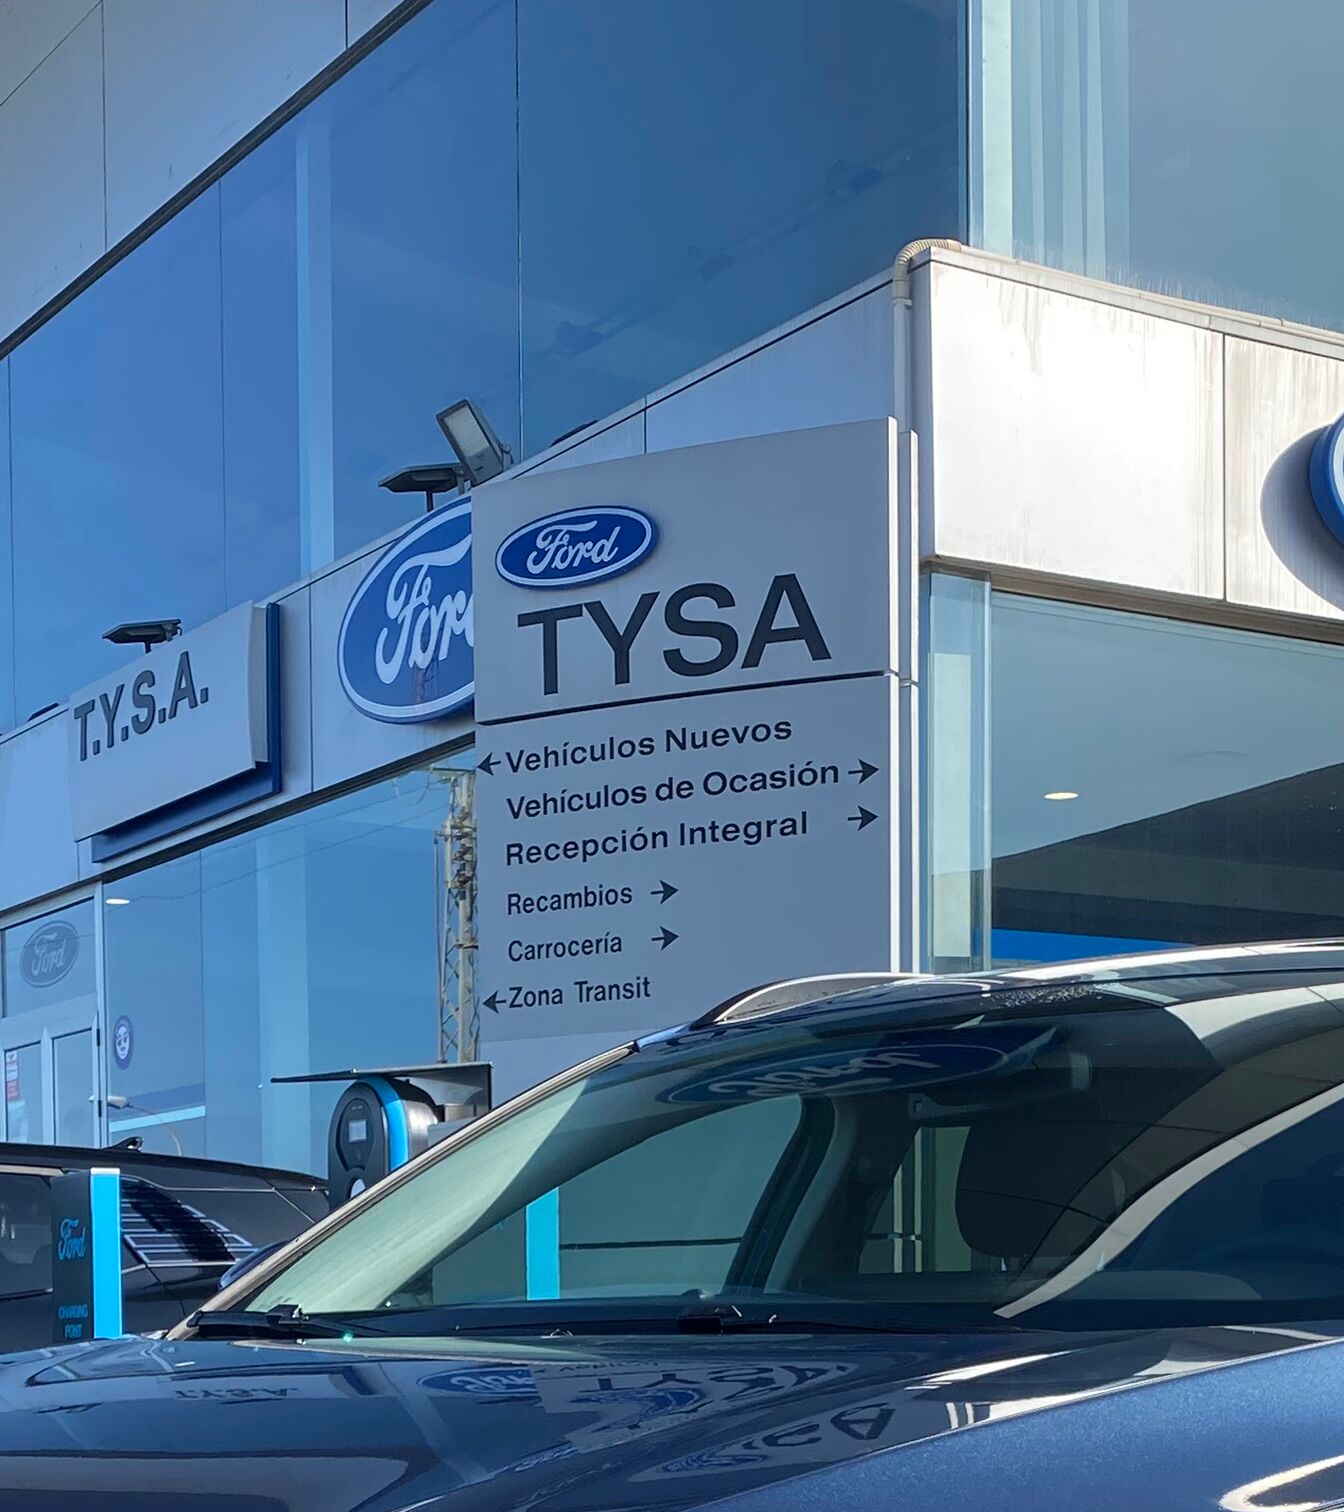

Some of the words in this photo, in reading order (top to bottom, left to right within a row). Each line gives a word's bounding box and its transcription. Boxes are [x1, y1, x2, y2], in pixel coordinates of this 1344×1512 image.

[527, 520, 620, 574] Ford
[375, 533, 473, 685] For
[517, 573, 832, 695] TYSA
[74, 650, 209, 762] T.Y.S.A.
[505, 736, 655, 773] Vehículos
[665, 720, 792, 753] Nuevos
[506, 784, 646, 820] Vehículos
[655, 777, 694, 801] de
[703, 761, 839, 796] Ocasión
[506, 827, 668, 866] Recepción
[680, 811, 807, 846] Integral
[507, 884, 633, 916] Recambios
[32, 932, 66, 976] Ford
[508, 932, 623, 962] Carrocería
[508, 986, 563, 1009] Zona
[573, 976, 651, 1003] Transit
[58, 1218, 86, 1260] Ford
